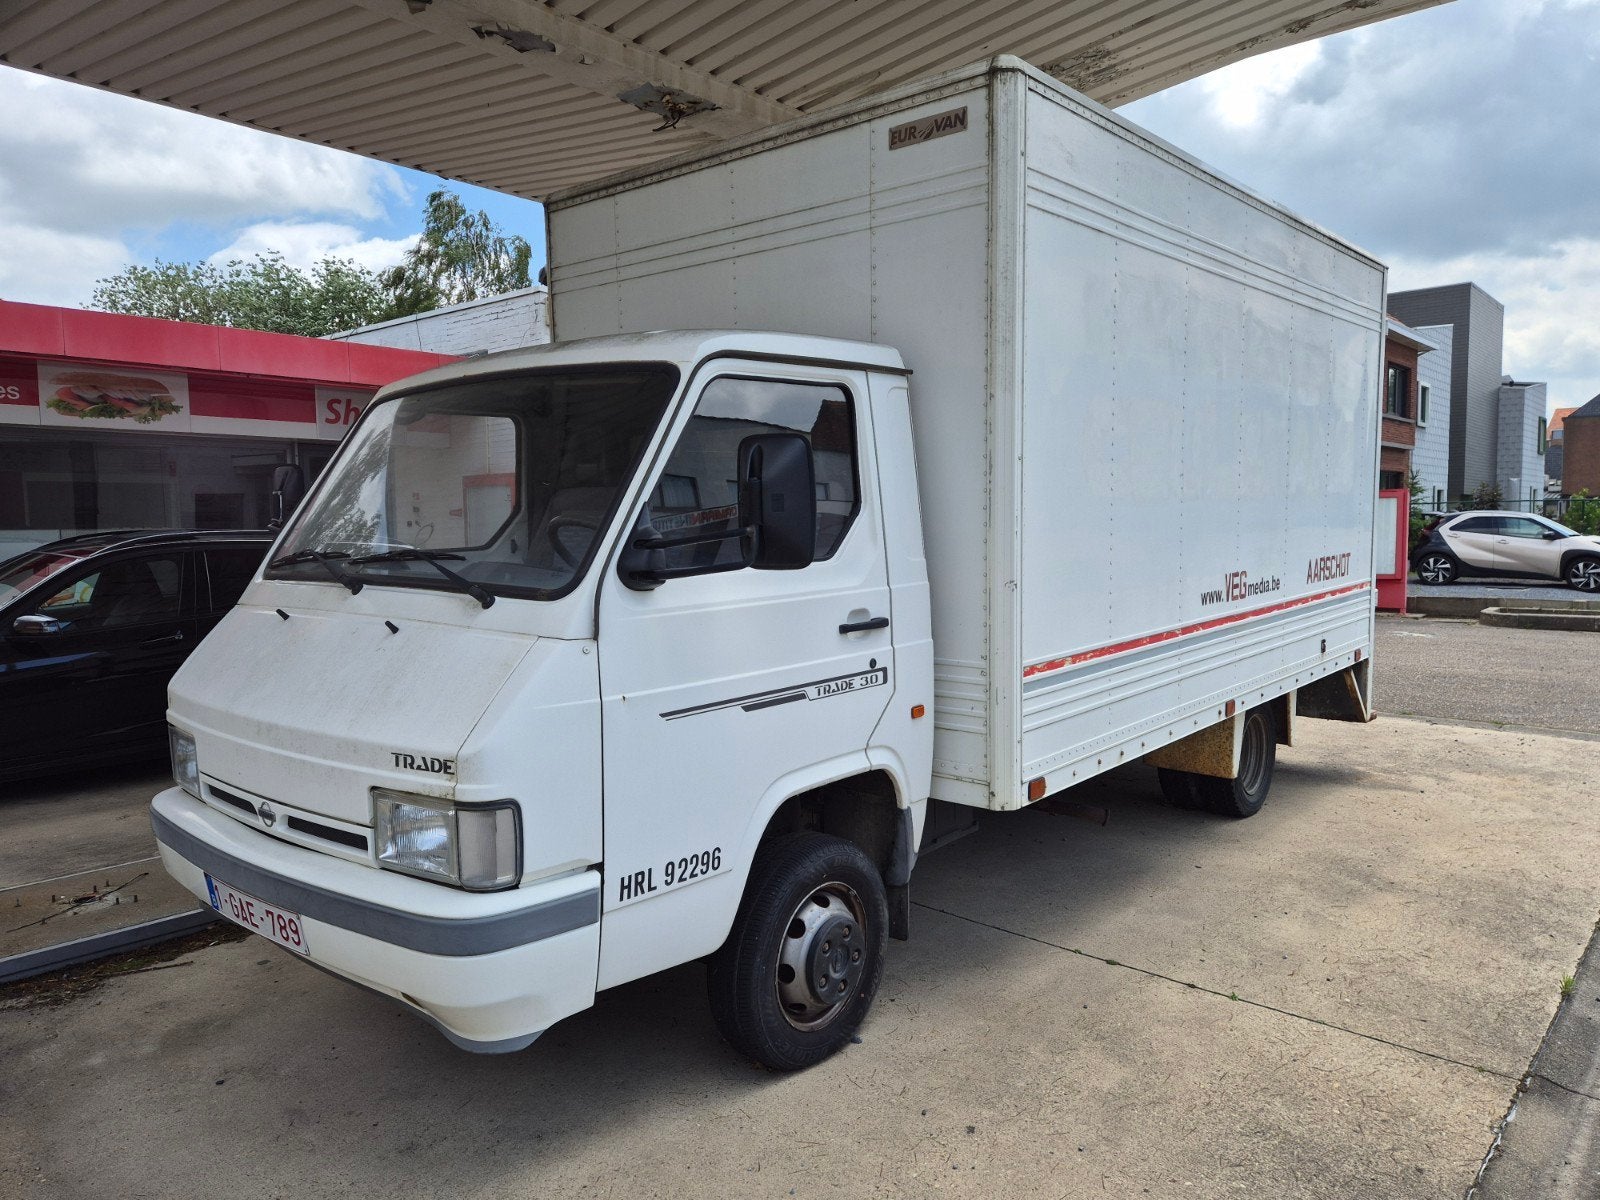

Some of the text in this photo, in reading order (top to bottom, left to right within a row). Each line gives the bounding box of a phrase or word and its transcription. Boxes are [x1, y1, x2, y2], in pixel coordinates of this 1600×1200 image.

[1306, 552, 1351, 584] AARSCHOT
[815, 679, 855, 696] TRADE
[391, 752, 455, 775] TRADE
[619, 847, 721, 902] HRL 92296
